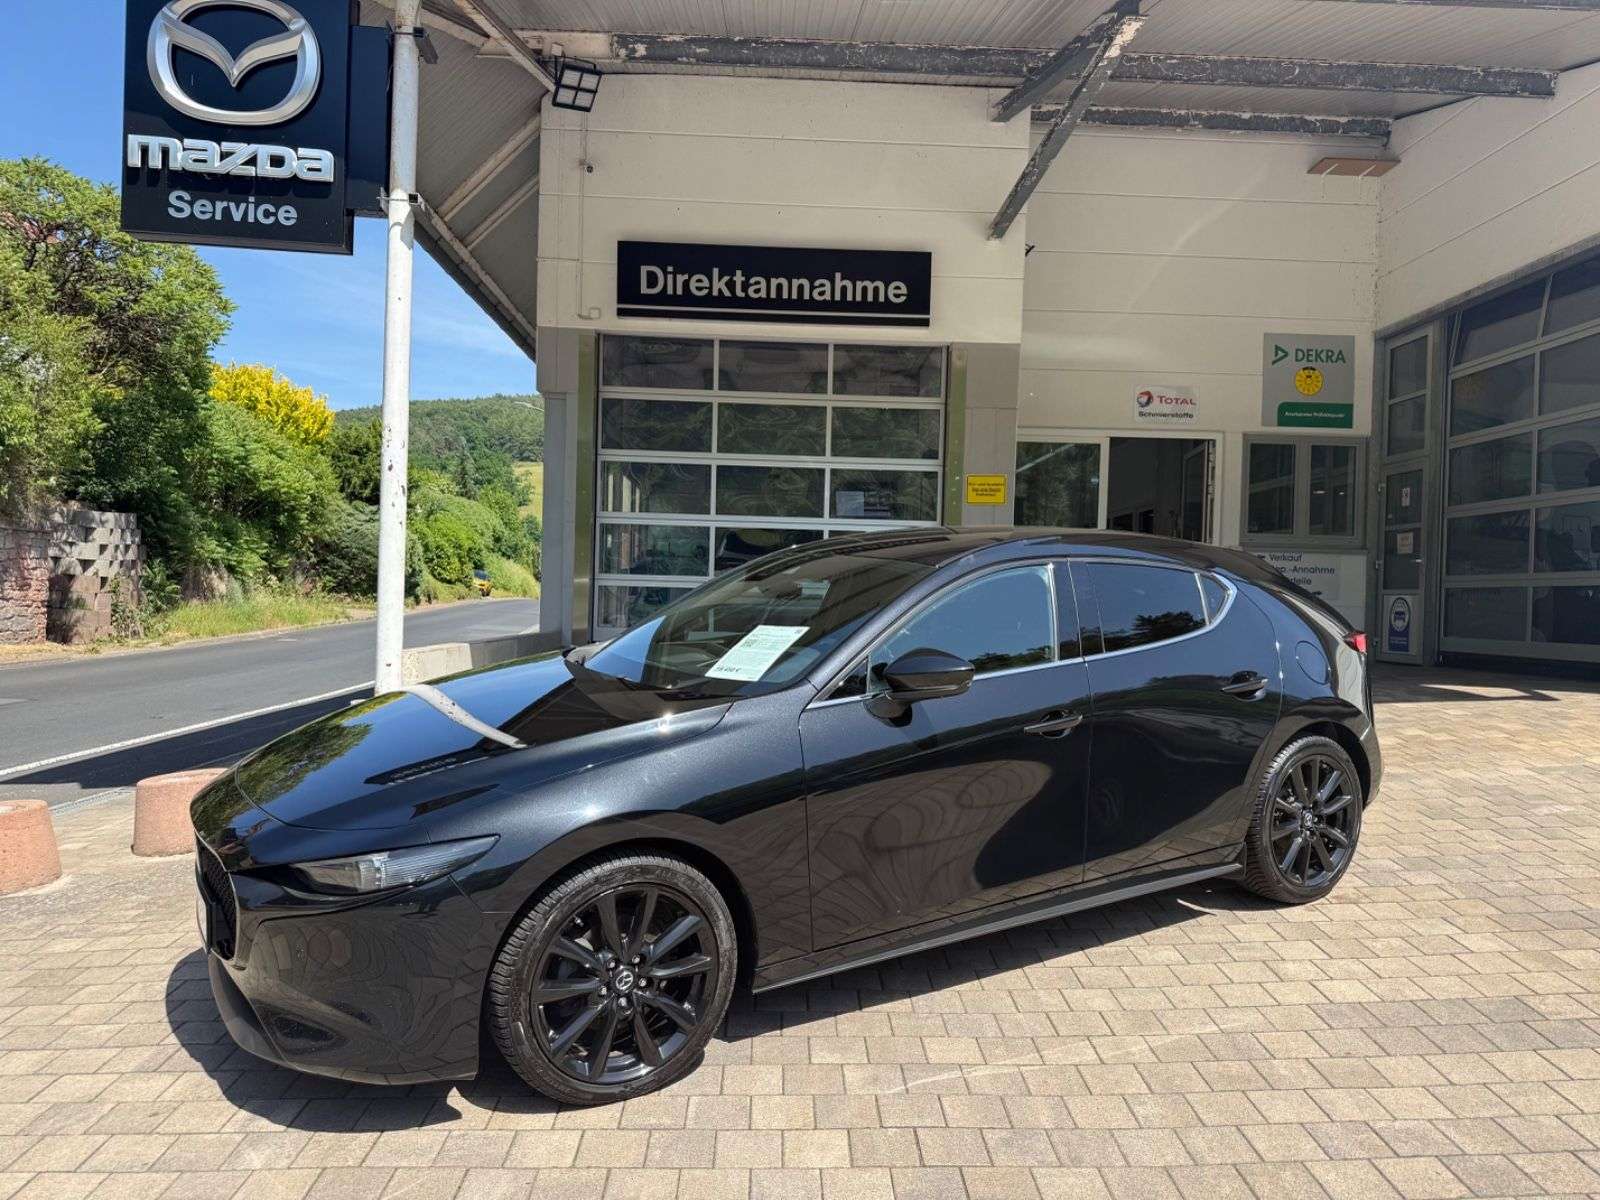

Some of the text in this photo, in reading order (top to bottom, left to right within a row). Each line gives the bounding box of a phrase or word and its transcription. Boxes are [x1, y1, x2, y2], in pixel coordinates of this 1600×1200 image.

[167, 190, 298, 226] Service
[639, 265, 908, 303] Direktannahme
[1294, 348, 1346, 364] DEKRA
[1157, 395, 1197, 406] TOTAL
[1138, 411, 1194, 419] Schmierstoffe
[1268, 553, 1303, 562] Verkauf
